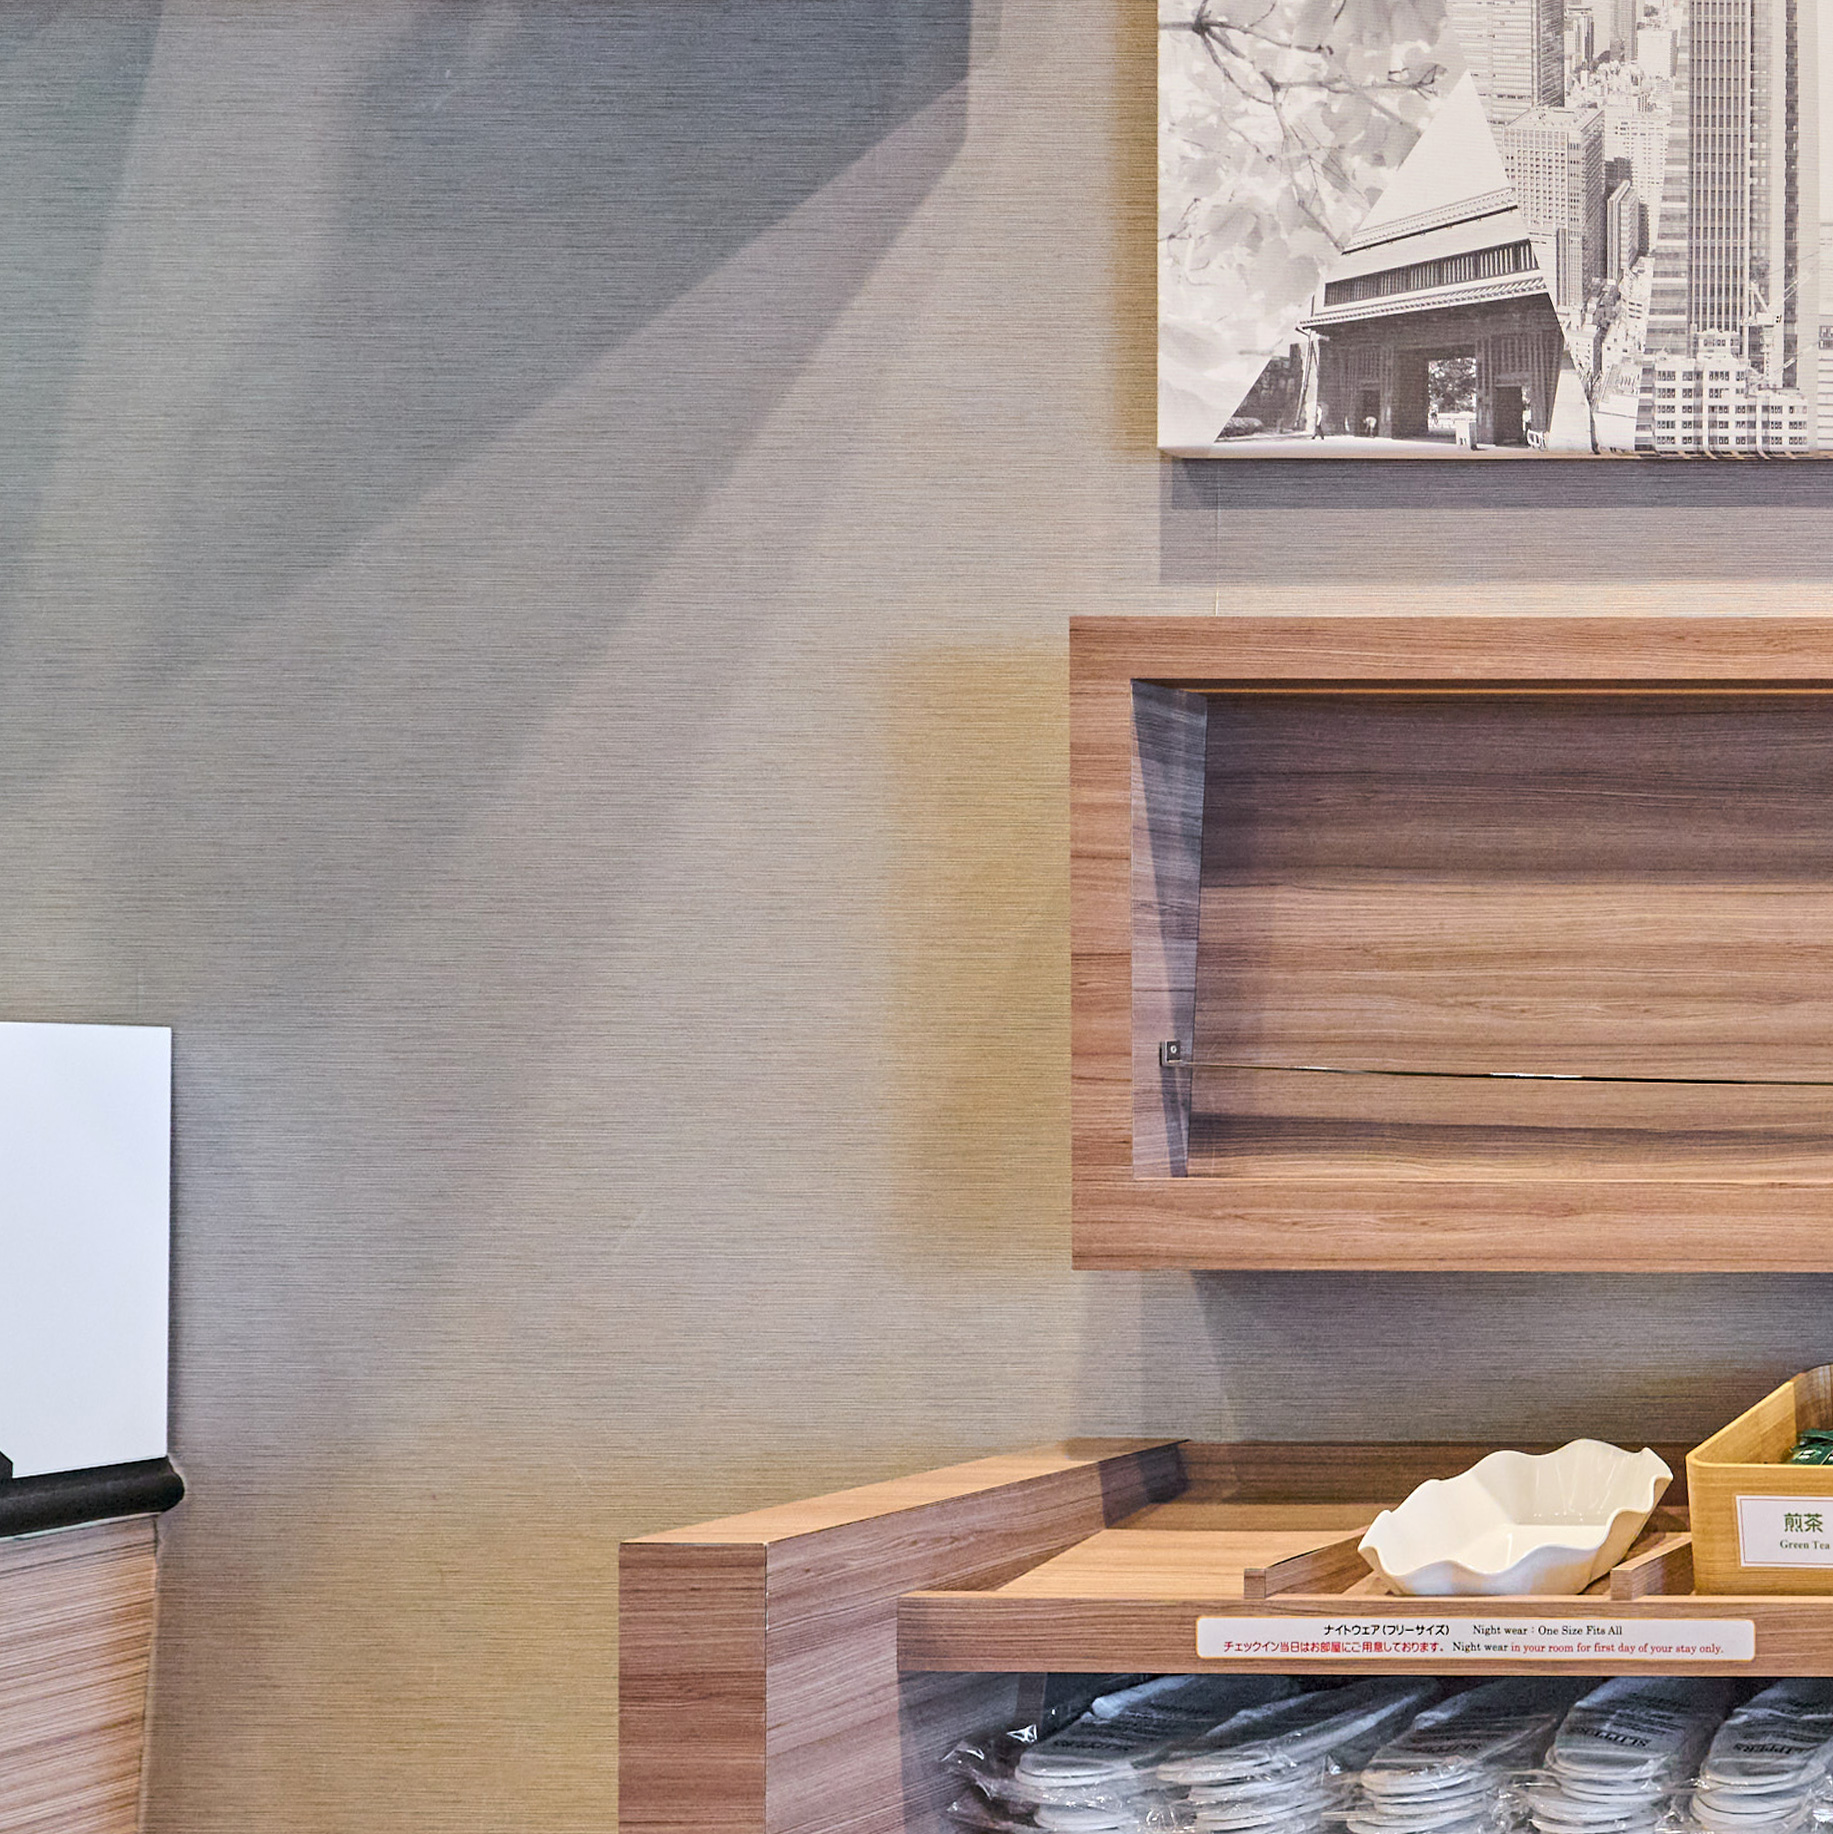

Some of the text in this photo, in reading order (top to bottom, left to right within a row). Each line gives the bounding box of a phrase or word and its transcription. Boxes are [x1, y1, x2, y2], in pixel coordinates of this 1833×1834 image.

[1783, 1512, 1824, 1533] 煎茶
[1779, 1539, 1831, 1550] Green Tea
[1472, 1624, 1502, 1637] Night
[1503, 1627, 1528, 1636] wear
[1537, 1624, 1559, 1636] One
[1561, 1625, 1584, 1636] Size
[1586, 1624, 1606, 1636] Fits
[1607, 1625, 1623, 1636] All
[1452, 1641, 1725, 1656] Night wear in your room for first day of your stay only.
